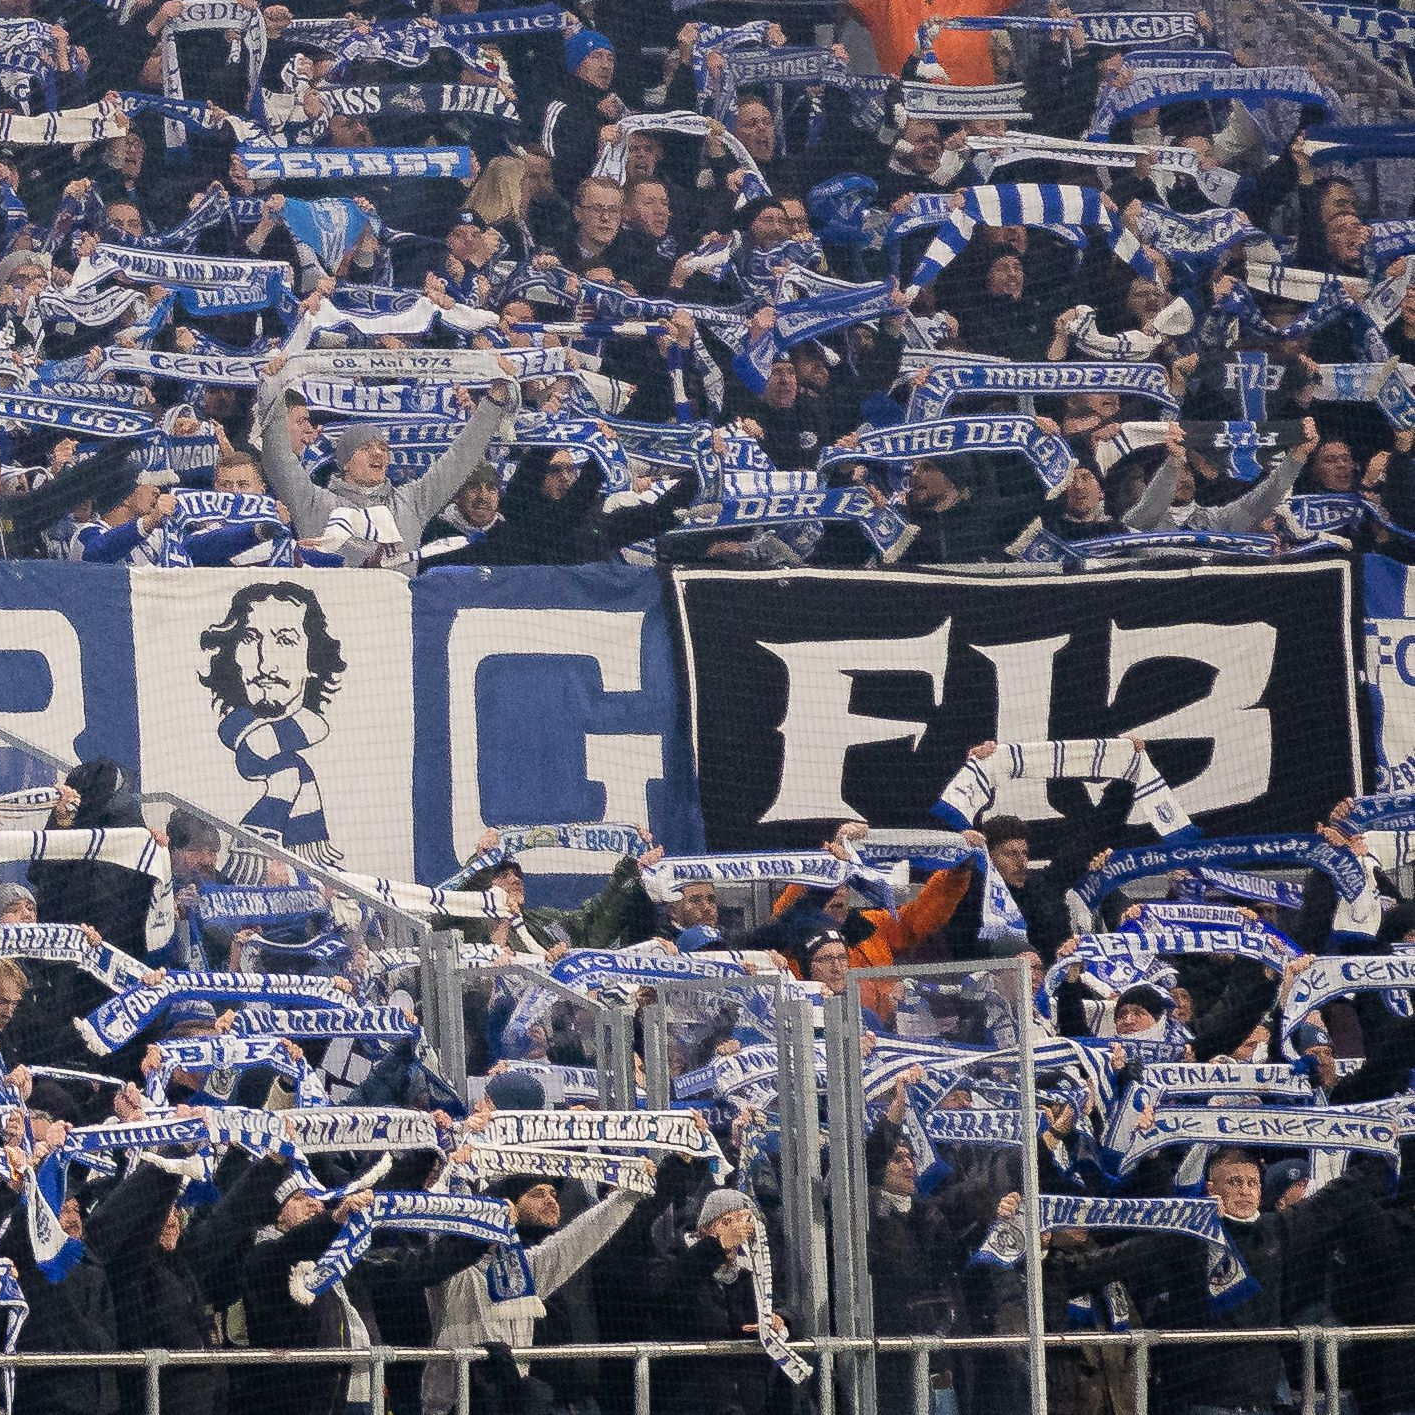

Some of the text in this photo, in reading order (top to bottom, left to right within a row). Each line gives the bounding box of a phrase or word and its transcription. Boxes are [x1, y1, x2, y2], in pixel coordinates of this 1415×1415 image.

[248, 149, 458, 177] ZERBST
[173, 258, 210, 280] VON
[409, 357, 453, 370] 1974
[72, 410, 141, 435] DER
[864, 419, 1027, 454] EITAG DER
[177, 491, 234, 519] ITAG
[735, 492, 826, 519] DER
[448, 608, 664, 836] G
[756, 617, 1276, 822] F13
[1144, 847, 1168, 865] die
[715, 860, 745, 881] VON
